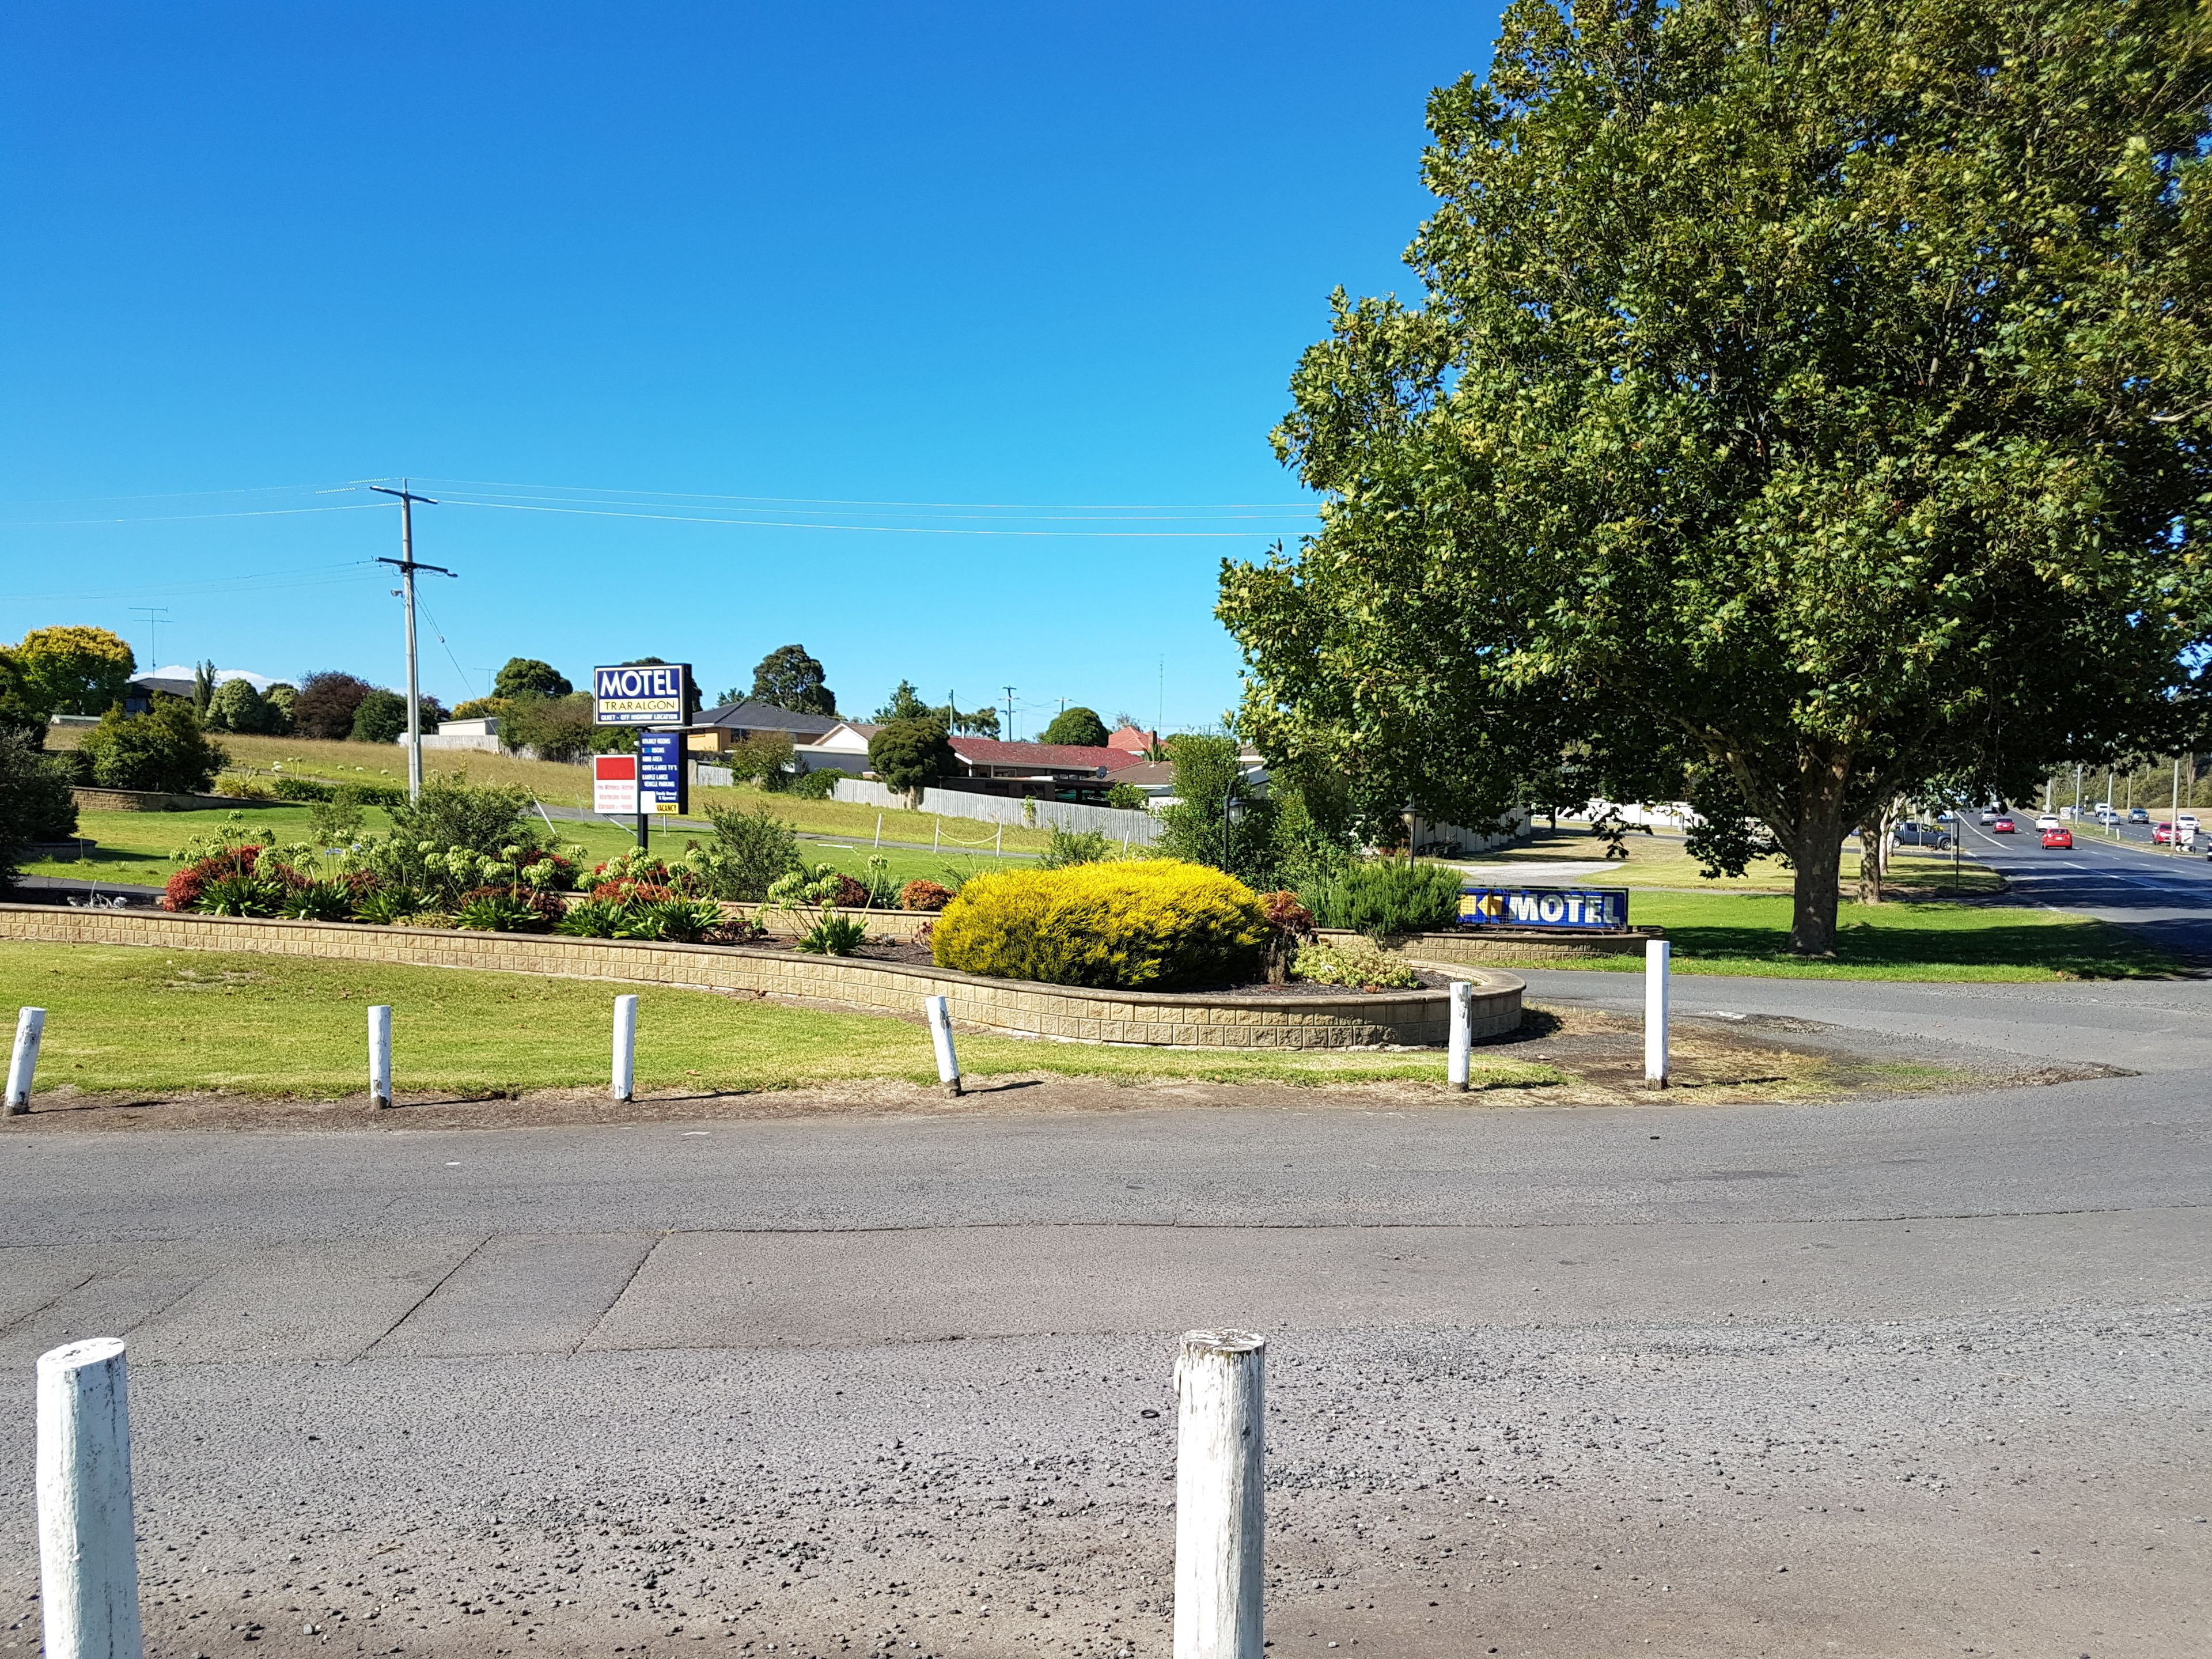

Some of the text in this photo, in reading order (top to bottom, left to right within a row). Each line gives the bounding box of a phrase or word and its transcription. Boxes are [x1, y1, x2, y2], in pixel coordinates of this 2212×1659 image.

[600, 670, 677, 696] MOTEL
[605, 700, 675, 710] TRARALGON
[1508, 893, 1620, 923] MOTEL
